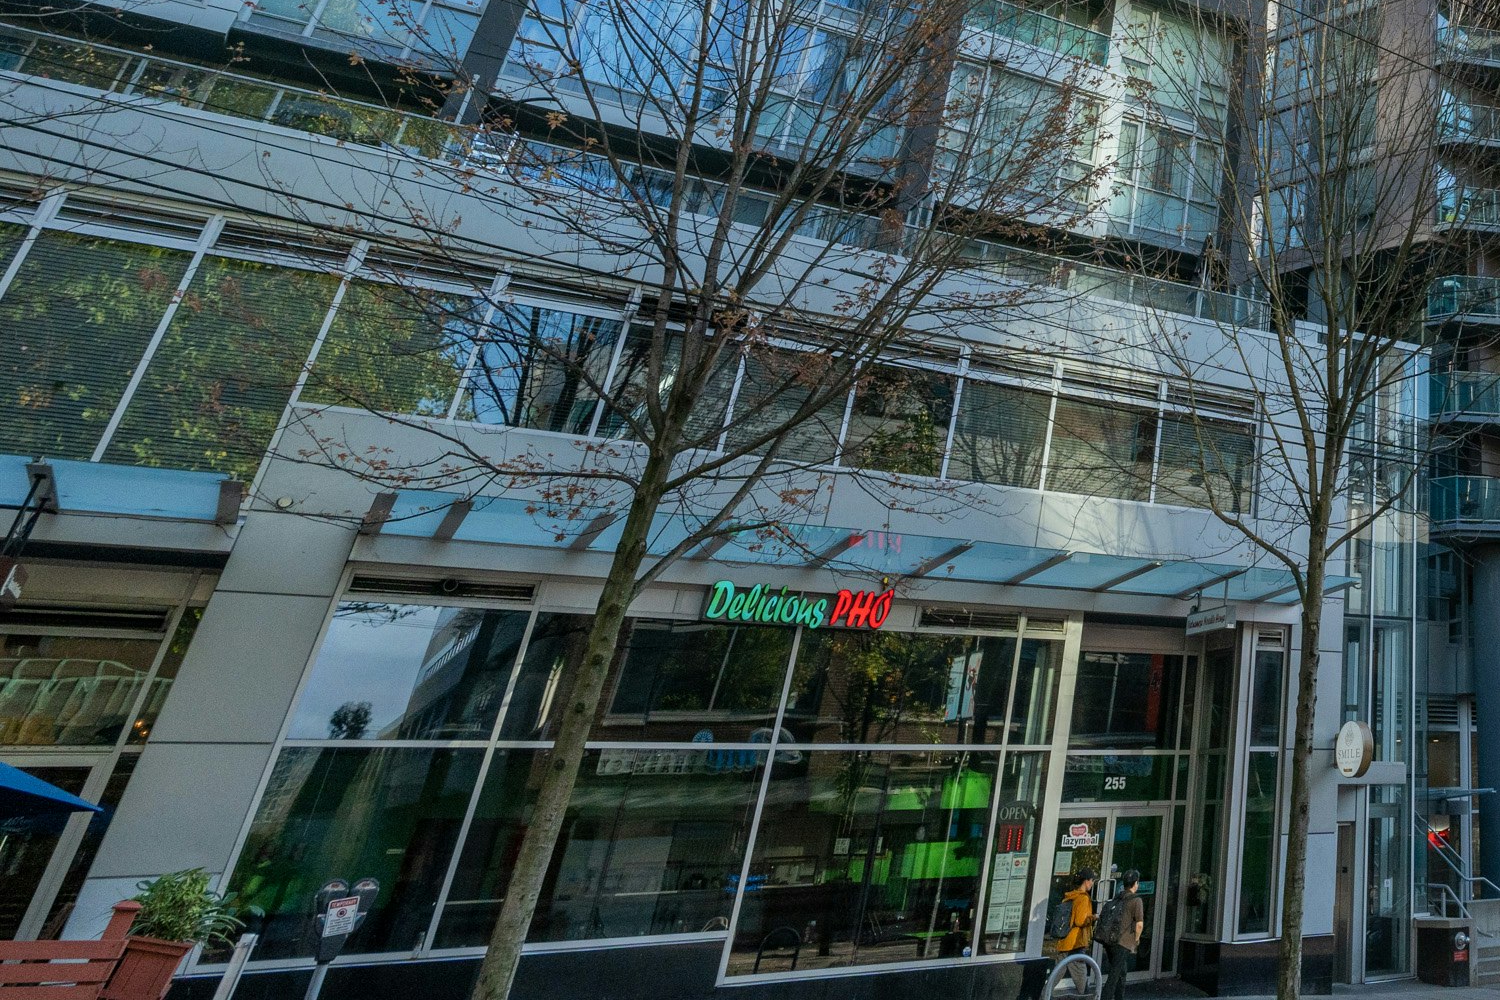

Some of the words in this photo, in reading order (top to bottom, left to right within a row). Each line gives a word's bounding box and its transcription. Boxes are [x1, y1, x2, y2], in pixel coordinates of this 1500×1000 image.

[705, 580, 828, 629] Delicious
[1338, 748, 1361, 760] SMILE
[1104, 776, 1126, 790] 255
[1000, 806, 1028, 820] OPEN
